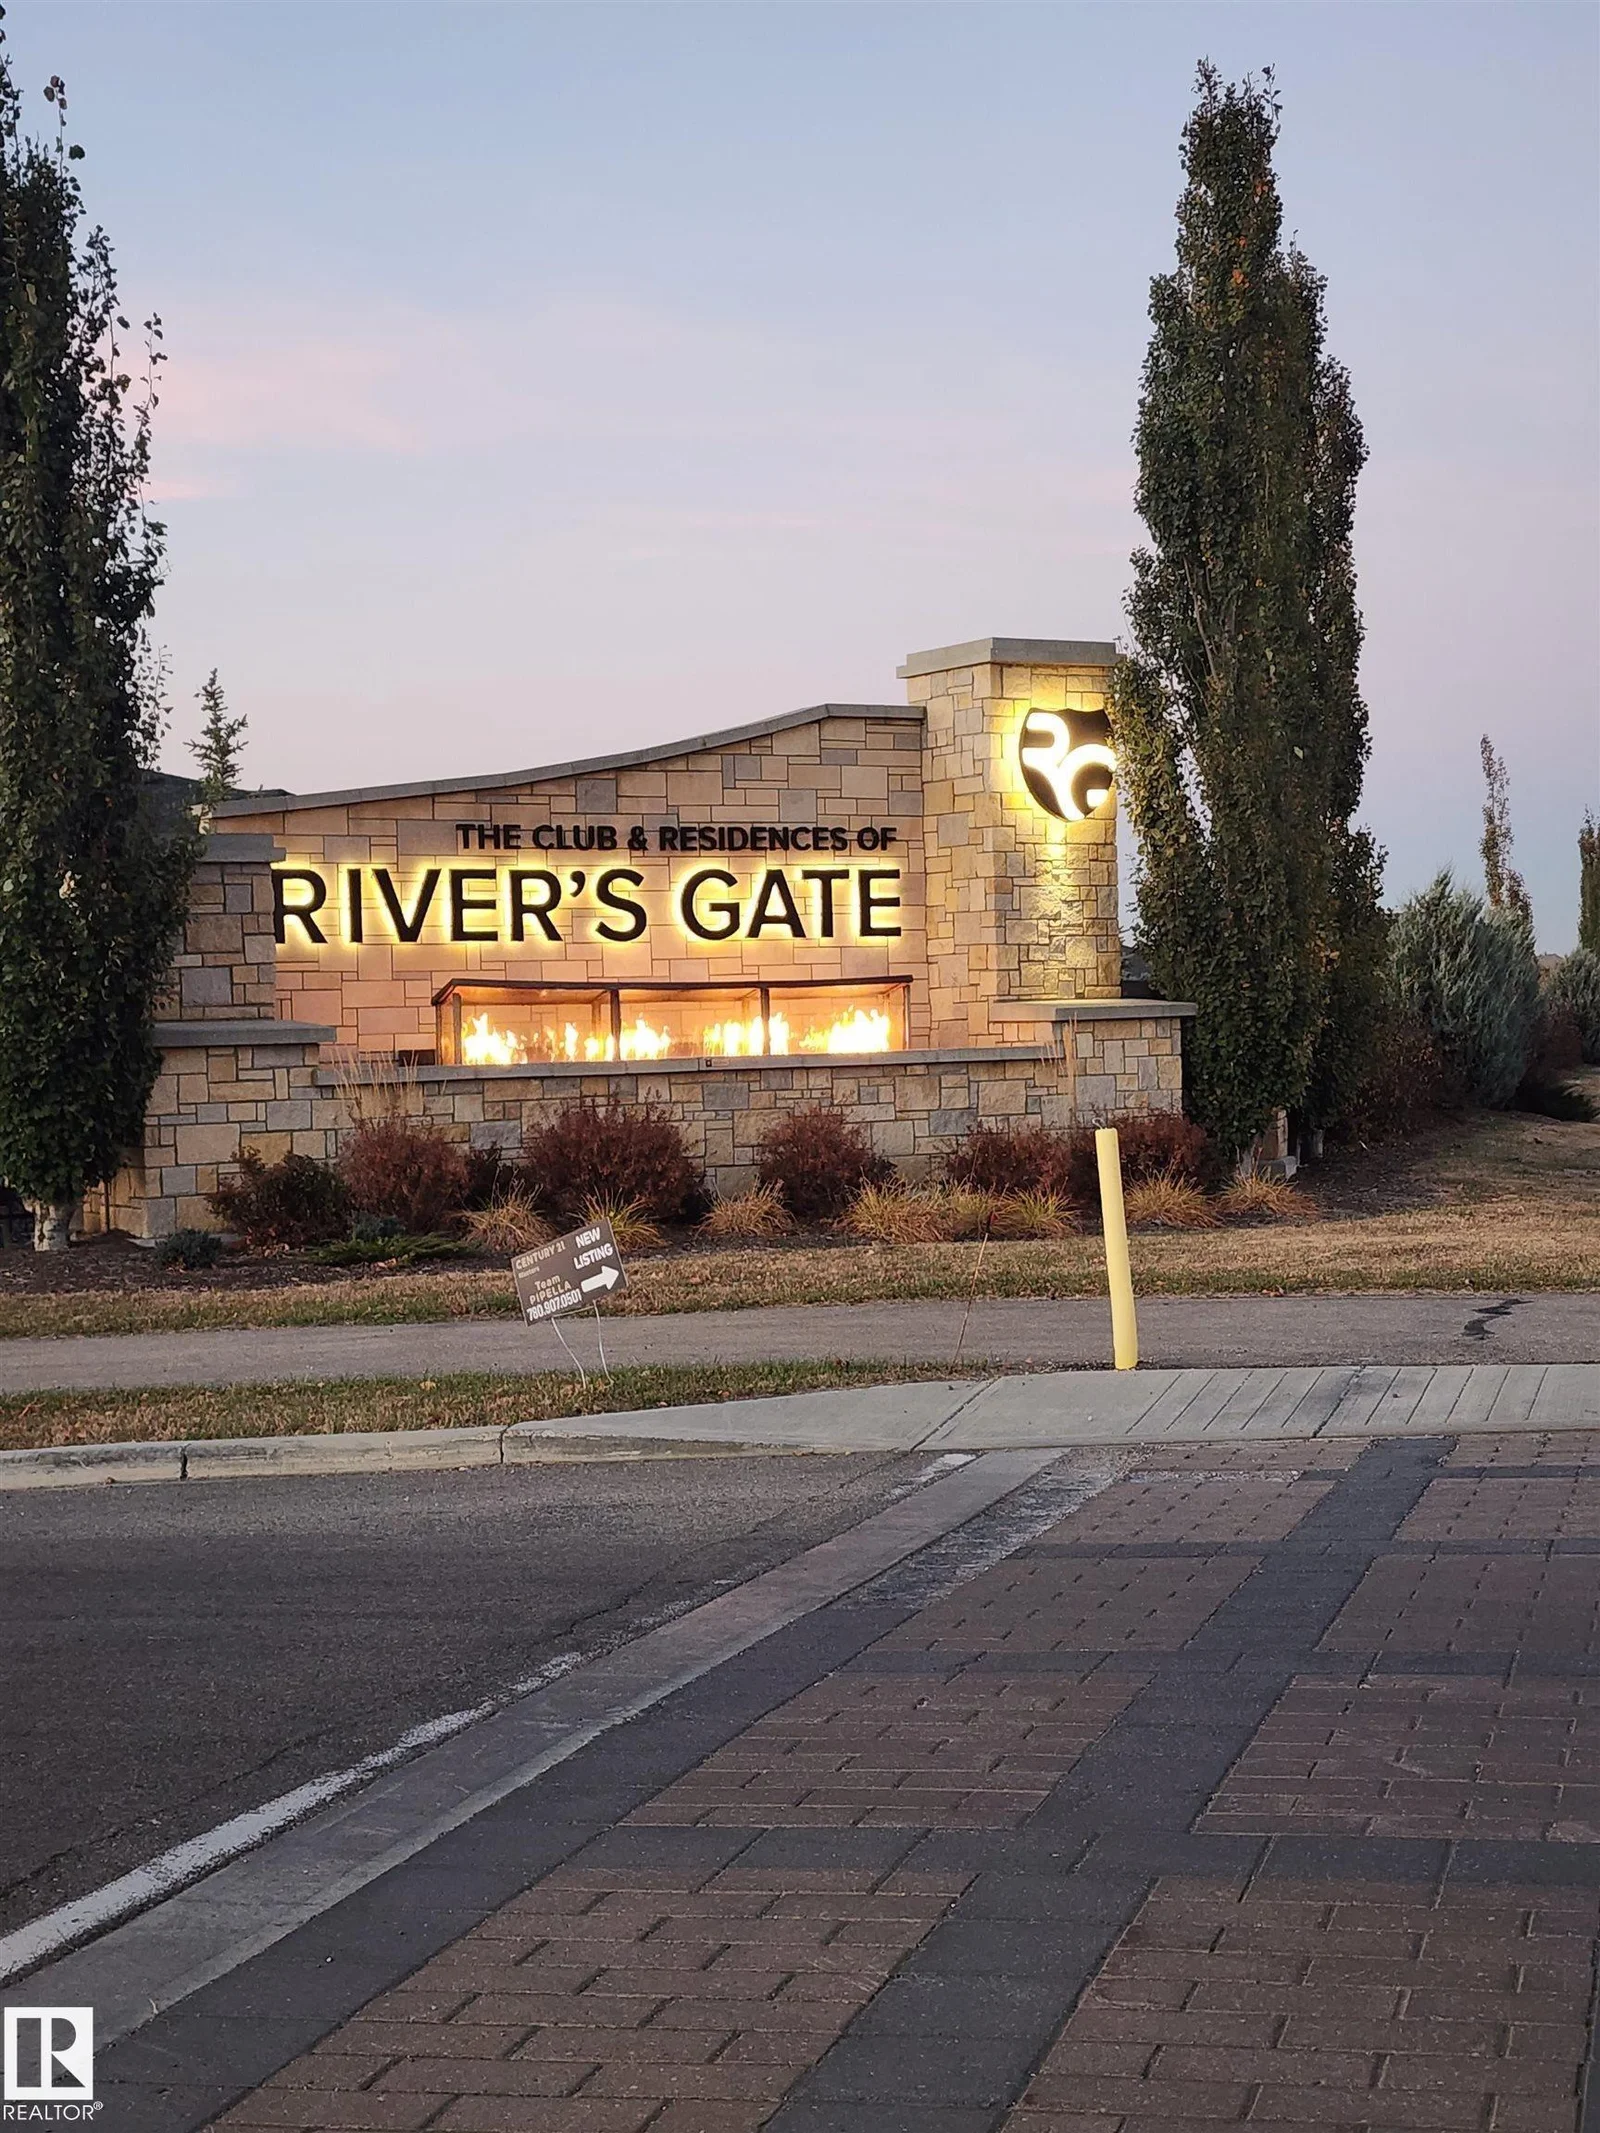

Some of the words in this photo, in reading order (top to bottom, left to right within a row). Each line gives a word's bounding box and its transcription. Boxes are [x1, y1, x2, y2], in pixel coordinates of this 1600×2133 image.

[456, 823, 521, 849] THE
[532, 824, 617, 851] CLUB
[627, 825, 648, 851] &
[659, 826, 848, 851] RESIDENCES
[857, 826, 897, 851] OF
[681, 868, 902, 941] GATE
[575, 1226, 601, 1248] NEW
[515, 1246, 555, 1270] CENTURY
[555, 1240, 566, 1253] 21
[573, 1242, 613, 1270] LISTING
[529, 1280, 572, 1305] PIPELLA
[534, 1274, 561, 1291] Team
[526, 1288, 582, 1321] 780.907.0501
